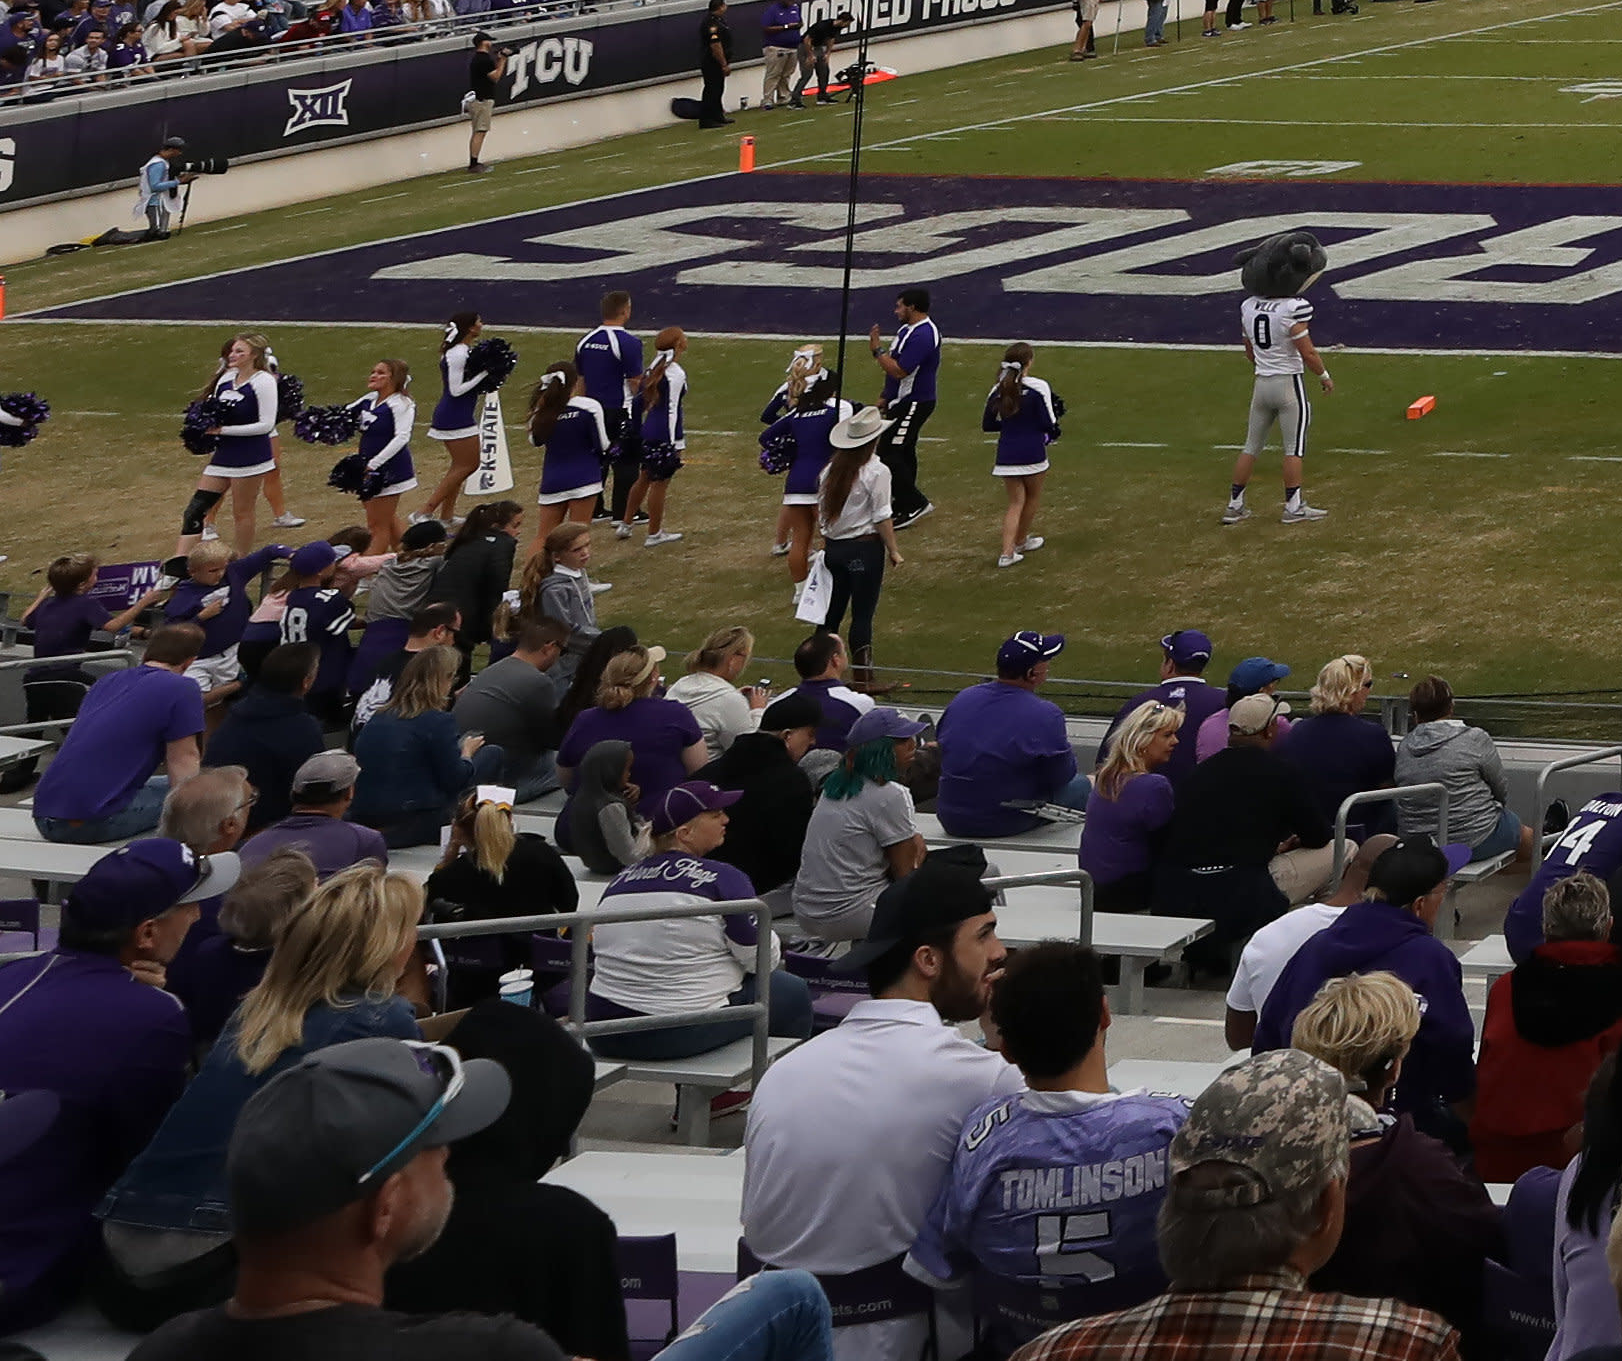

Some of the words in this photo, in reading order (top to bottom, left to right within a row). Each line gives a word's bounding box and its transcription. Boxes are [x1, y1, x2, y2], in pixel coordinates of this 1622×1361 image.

[506, 37, 593, 100] TCU
[283, 78, 352, 138] XII
[1253, 313, 1272, 350] 0
[481, 400, 498, 472] K-STATE
[1000, 1149, 1166, 1213] TOMLINSON
[1034, 1208, 1118, 1286] 5
